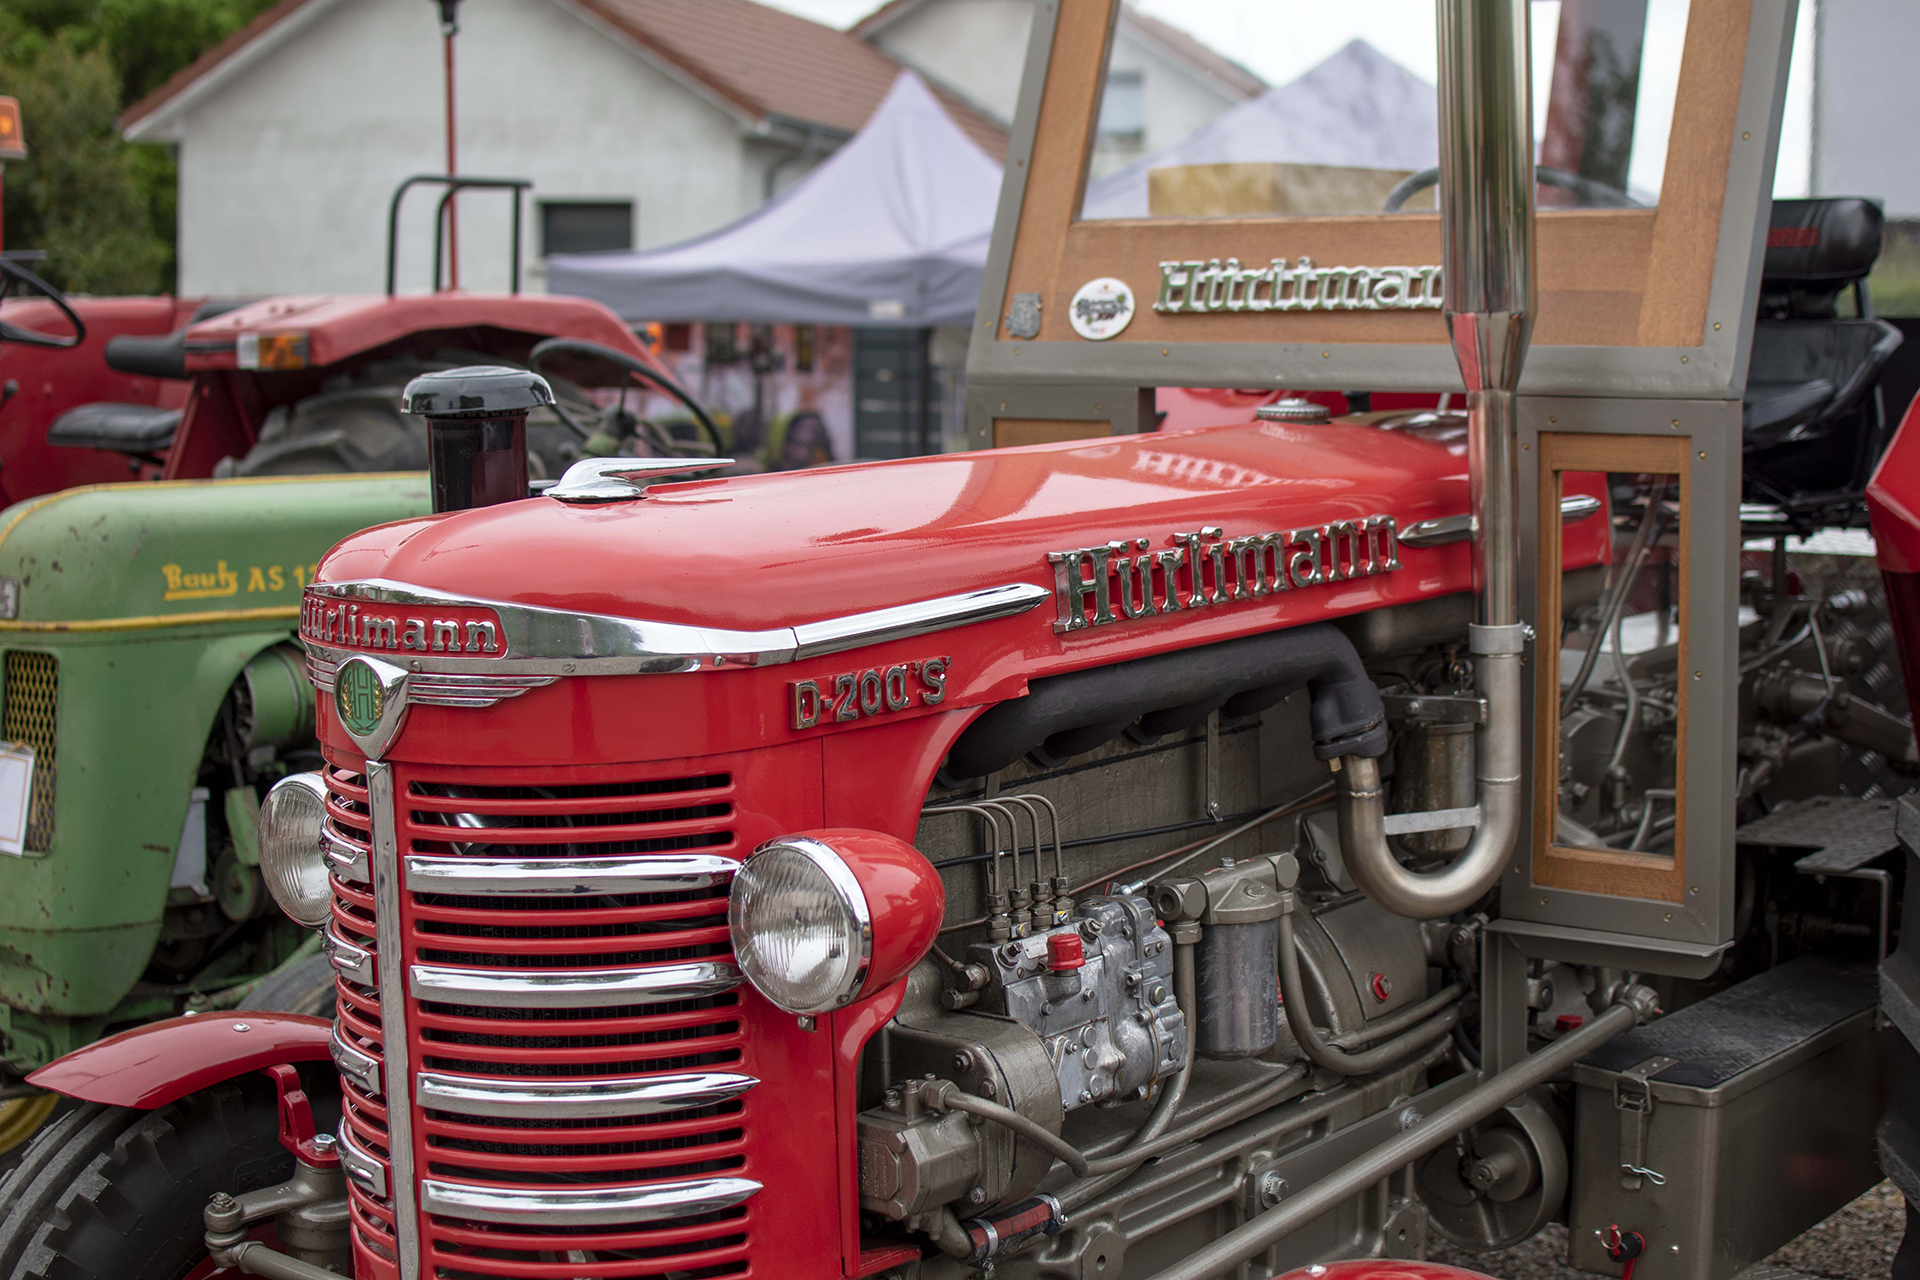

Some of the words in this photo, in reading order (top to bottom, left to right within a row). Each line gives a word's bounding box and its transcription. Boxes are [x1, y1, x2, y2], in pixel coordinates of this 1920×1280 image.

[1152, 257, 1443, 312] Hürliman
[161, 560, 238, 600] Bautz
[247, 565, 284, 593] AS
[1048, 514, 1402, 634] Hürlimann
[302, 597, 498, 652] Hürlimann
